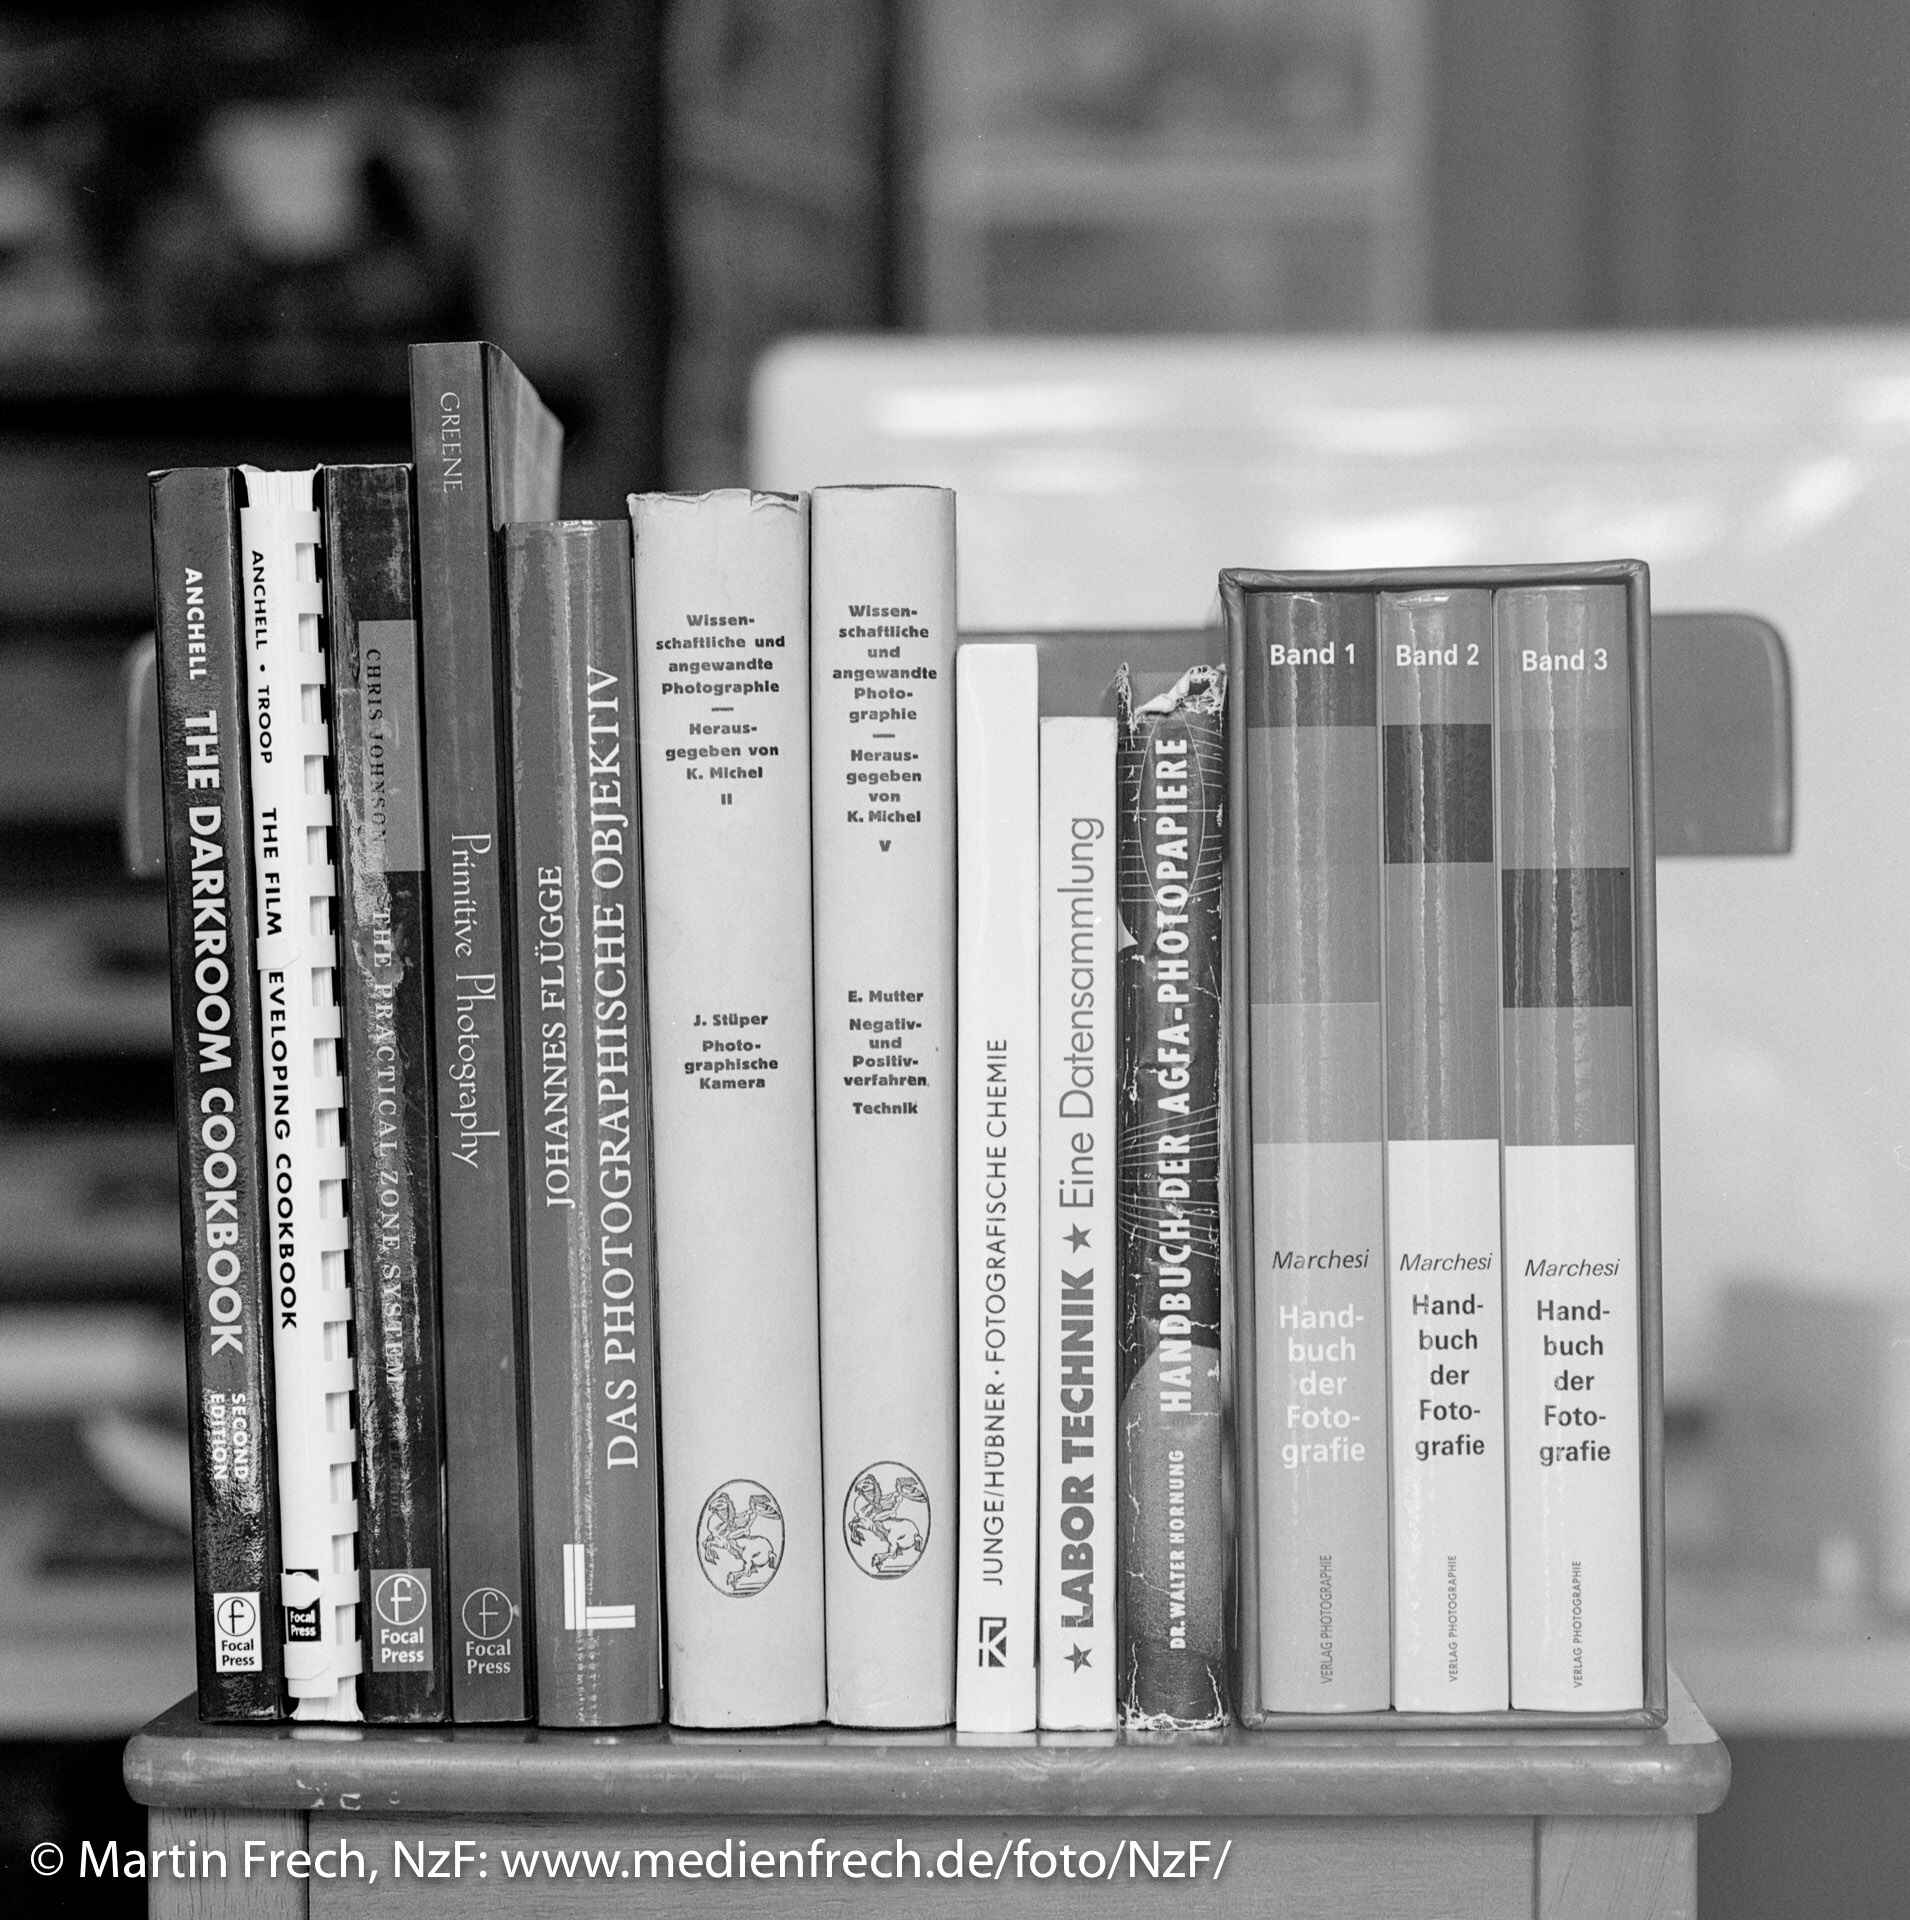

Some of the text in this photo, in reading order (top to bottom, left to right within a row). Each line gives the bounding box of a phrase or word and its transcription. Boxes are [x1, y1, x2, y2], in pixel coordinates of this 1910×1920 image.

[439, 391, 464, 493] GREENE
[686, 614, 756, 627] Wissen-
[848, 605, 918, 618] Wissen-
[184, 567, 207, 681] ANCHELL
[838, 624, 929, 640] schaftliche
[655, 635, 786, 651] schaftliche und
[867, 645, 901, 659] und
[251, 550, 274, 765] ANCHELL TROOP
[1269, 643, 1356, 666] Band 1
[1395, 644, 1480, 667] Band 2
[1521, 648, 1608, 672] Band 3
[668, 658, 774, 675] angewandte
[832, 666, 938, 682] angewandte
[366, 648, 383, 721] CHRIS
[661, 680, 780, 697] Photographie
[853, 686, 914, 700] Photo-
[848, 706, 918, 724] graphie
[689, 722, 758, 736] Heraus-
[665, 744, 780, 762] gegeben von
[849, 748, 919, 762] Heraus-
[686, 766, 763, 781] K. Michel
[845, 769, 922, 786] gegeben
[721, 793, 734, 806] II
[868, 790, 901, 803] von
[847, 809, 922, 824] K. Michel
[878, 839, 892, 853] V
[449, 832, 500, 1170] Primitive Photography
[847, 989, 924, 1003] E. Mutter
[693, 1011, 769, 1030] J. Stüper
[848, 1017, 922, 1034] Negativ-
[186, 711, 244, 1357] THE DARKROOM COOKBOOK
[534, 865, 576, 1208] JOHANNES FLÜGGE
[868, 1037, 902, 1050] und
[702, 1039, 761, 1052] Photo-
[261, 808, 298, 1330] THE FILM EVELOPING COOKBOOK
[587, 665, 639, 1470] DAS PHOTOGRAPHISCHE OBJEKTIV
[684, 1056, 779, 1076] graphische
[852, 1054, 919, 1069] Positiv-
[699, 1077, 766, 1091] Kamera
[1155, 738, 1192, 1413] HANDBUCH DER AGFA-PHOTOPAPIERE
[852, 1101, 919, 1116] Technik
[373, 907, 405, 1387] THE PRACTICAL ZONE SYSTEM
[1056, 816, 1105, 1628] LABOR TECHNIK Eine Datensammlung
[1271, 1248, 1370, 1271] Marchesi
[1399, 1252, 1493, 1273] Marchesi
[1524, 1257, 1621, 1279] Marchesi
[981, 1038, 1008, 1586] JUNGE/HÜBNER FOTOGRAFISCHE CHEMIE
[1411, 1293, 1484, 1316] Hand-
[1535, 1299, 1611, 1322] Hand-
[1278, 1303, 1365, 1330] Hand-
[1288, 1335, 1356, 1363] buch
[1418, 1328, 1479, 1351] buch
[1543, 1334, 1604, 1357] buch
[1298, 1370, 1348, 1396] der
[1430, 1364, 1470, 1386] der
[1553, 1370, 1596, 1392] der
[1286, 1405, 1361, 1430] Foto-
[1418, 1399, 1481, 1421] Foto-
[1543, 1405, 1607, 1427] Foto-
[211, 1393, 229, 1481] EDITION
[231, 1392, 249, 1481] SECOND
[1281, 1437, 1367, 1470] grafie
[1414, 1434, 1486, 1462] grafie
[1539, 1440, 1612, 1467] grafie
[1169, 1449, 1187, 1650] DR. WALTER HORNUNG
[290, 1609, 316, 1624] Focal
[1320, 1554, 1333, 1685] VERLAG PHOTOGRAPHIE
[1447, 1554, 1458, 1683] VERLAG PHOTOGRAPHIE
[1572, 1560, 1584, 1688] VERLAG PHOTOGRAPHIE
[290, 1624, 317, 1637] Press
[380, 1626, 424, 1645] Focal
[221, 1638, 255, 1652] Focal
[381, 1647, 425, 1664] Press
[465, 1638, 512, 1658] Focal
[222, 1654, 255, 1668] Press
[466, 1658, 512, 1676] Press
